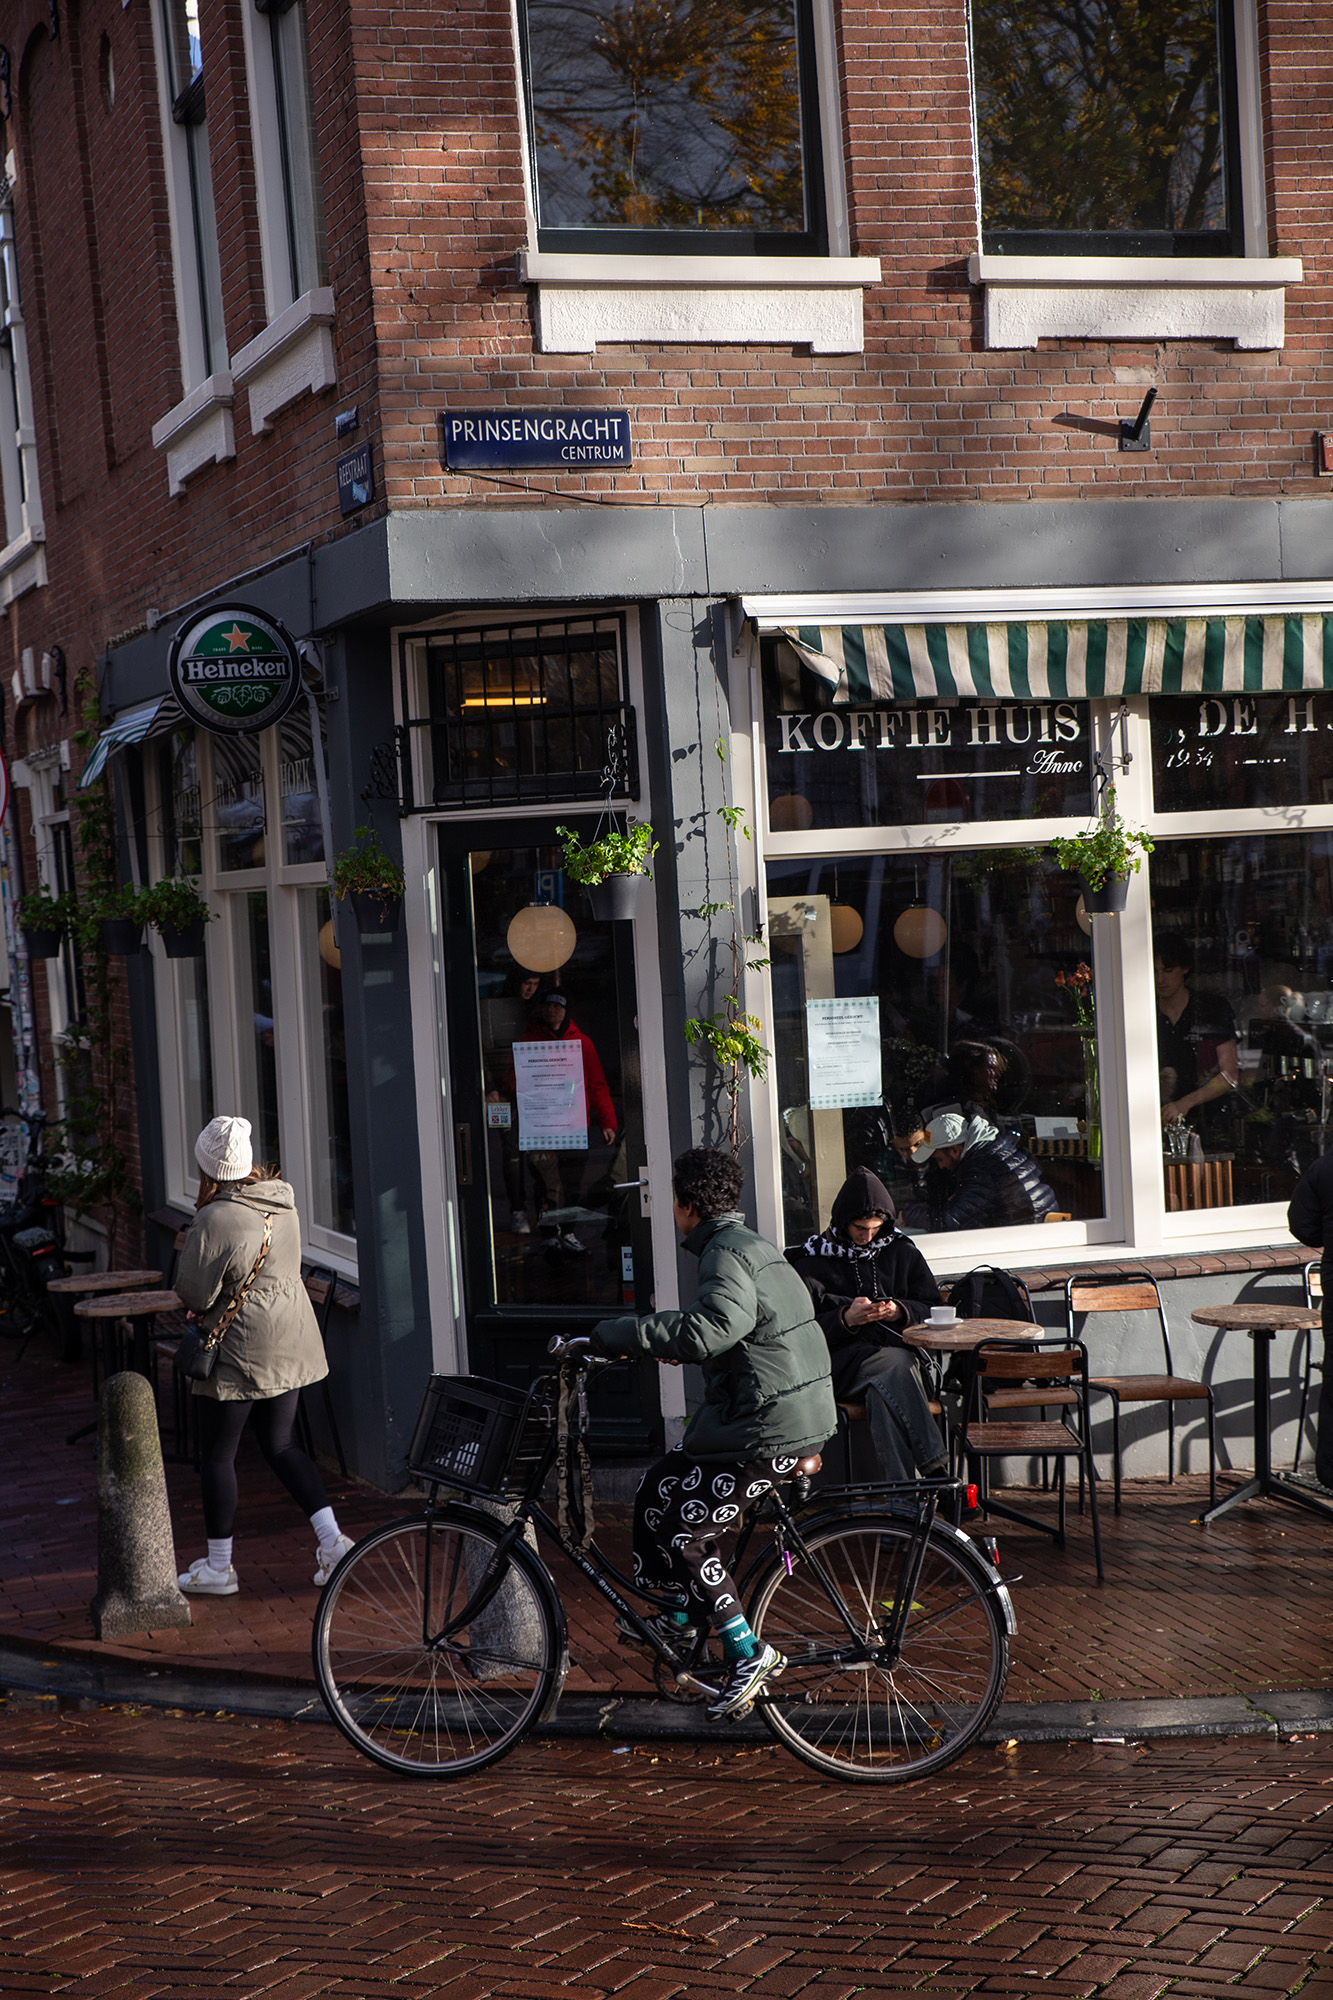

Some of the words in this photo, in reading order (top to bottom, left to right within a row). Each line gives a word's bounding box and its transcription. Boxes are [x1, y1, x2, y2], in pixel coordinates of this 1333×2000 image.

[451, 418, 622, 442] PRINSENGRACHT
[561, 446, 624, 460] CENTRUM
[338, 453, 367, 488] REESTRAAT
[186, 658, 287, 680] Heineken
[776, 708, 951, 753] KOFFIE
[965, 703, 1081, 746] HUIS
[1025, 749, 1083, 775] Anno
[280, 758, 312, 798] HOEK
